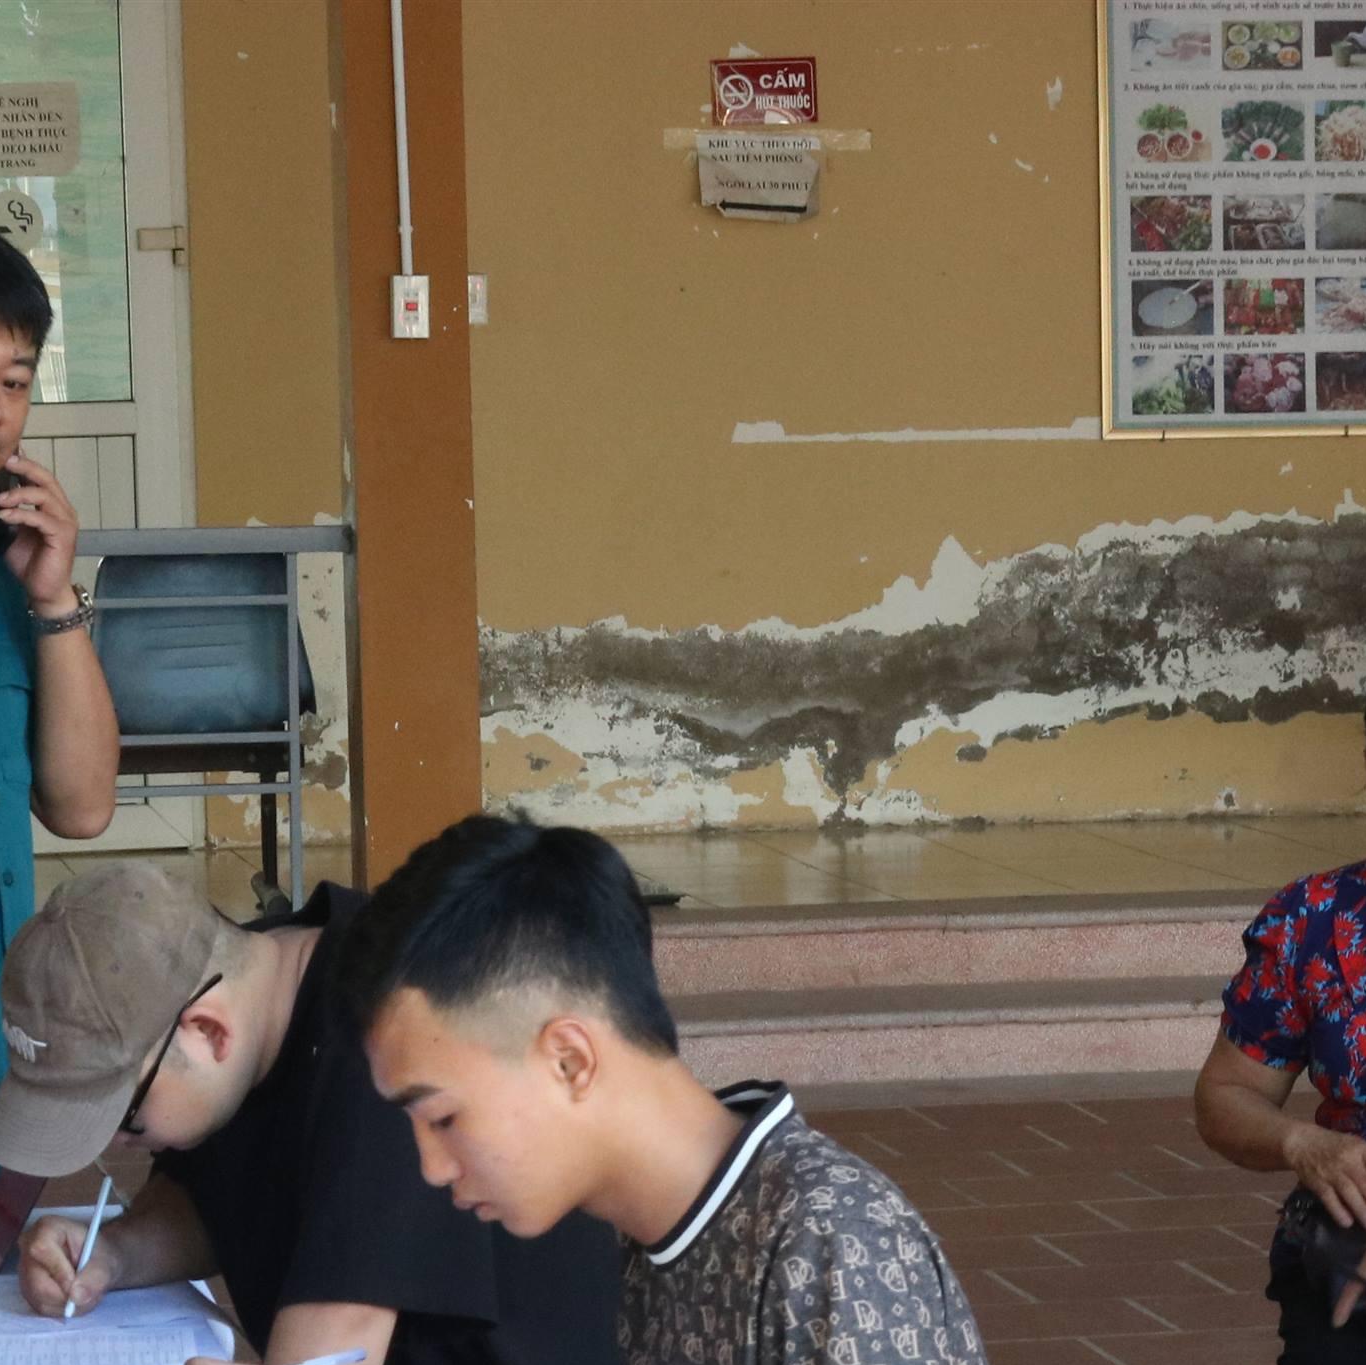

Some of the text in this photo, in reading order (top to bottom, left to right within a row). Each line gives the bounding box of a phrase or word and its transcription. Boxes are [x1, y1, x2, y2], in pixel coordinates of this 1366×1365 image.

[758, 67, 806, 89] CẤM
[755, 89, 811, 110] HÚT THUỐC
